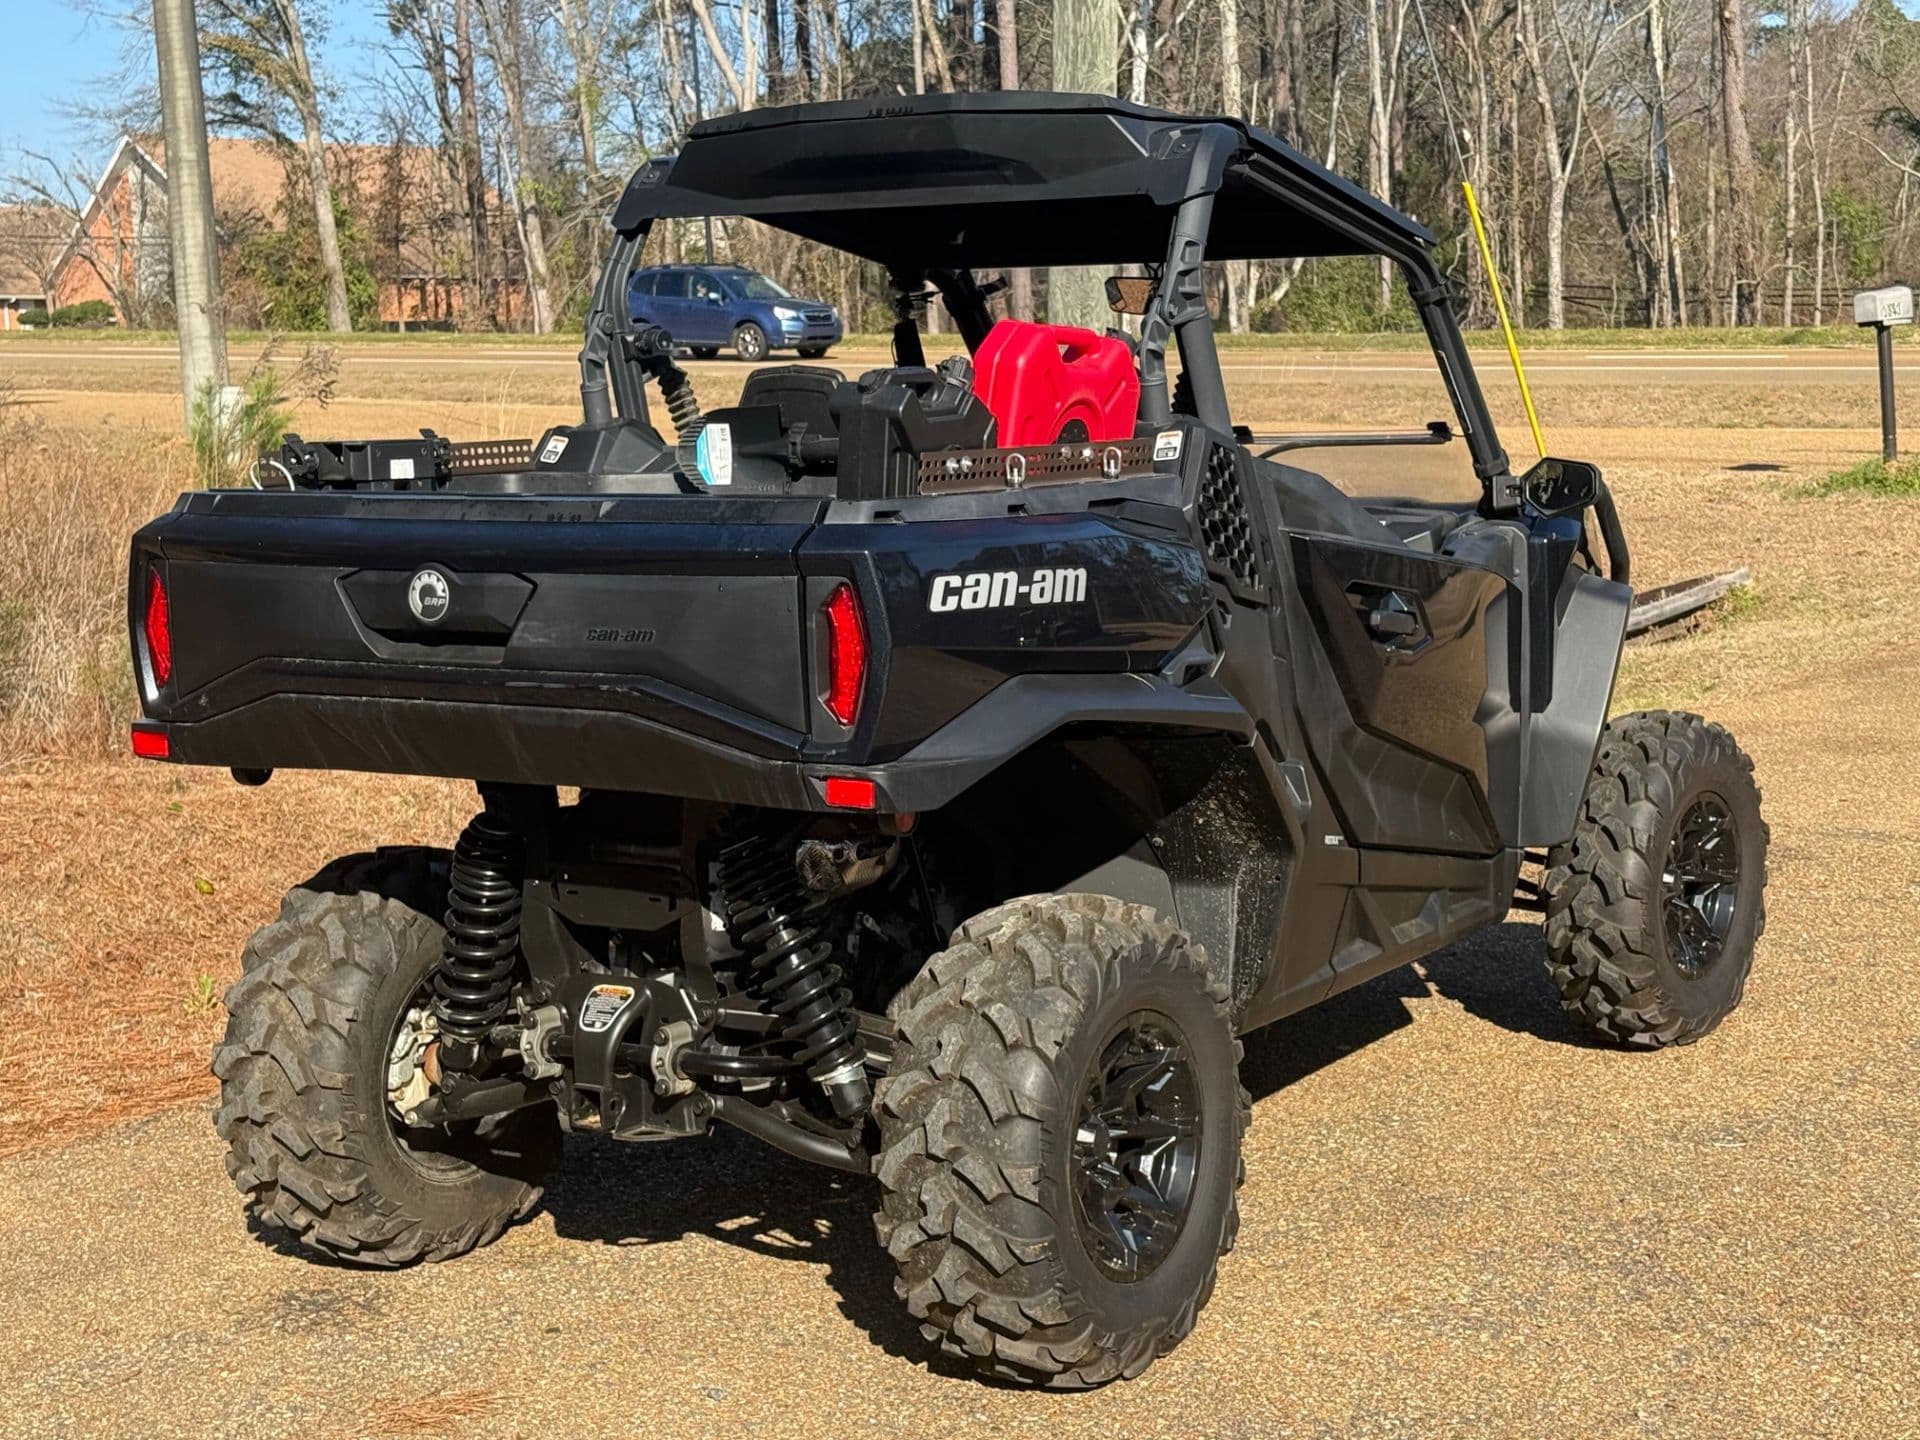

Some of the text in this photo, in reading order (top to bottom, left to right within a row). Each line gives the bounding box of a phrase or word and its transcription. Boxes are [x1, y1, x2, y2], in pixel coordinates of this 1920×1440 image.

[929, 568, 1088, 613] can-am
[424, 597, 446, 607] BRP
[587, 628, 656, 643] can-am
